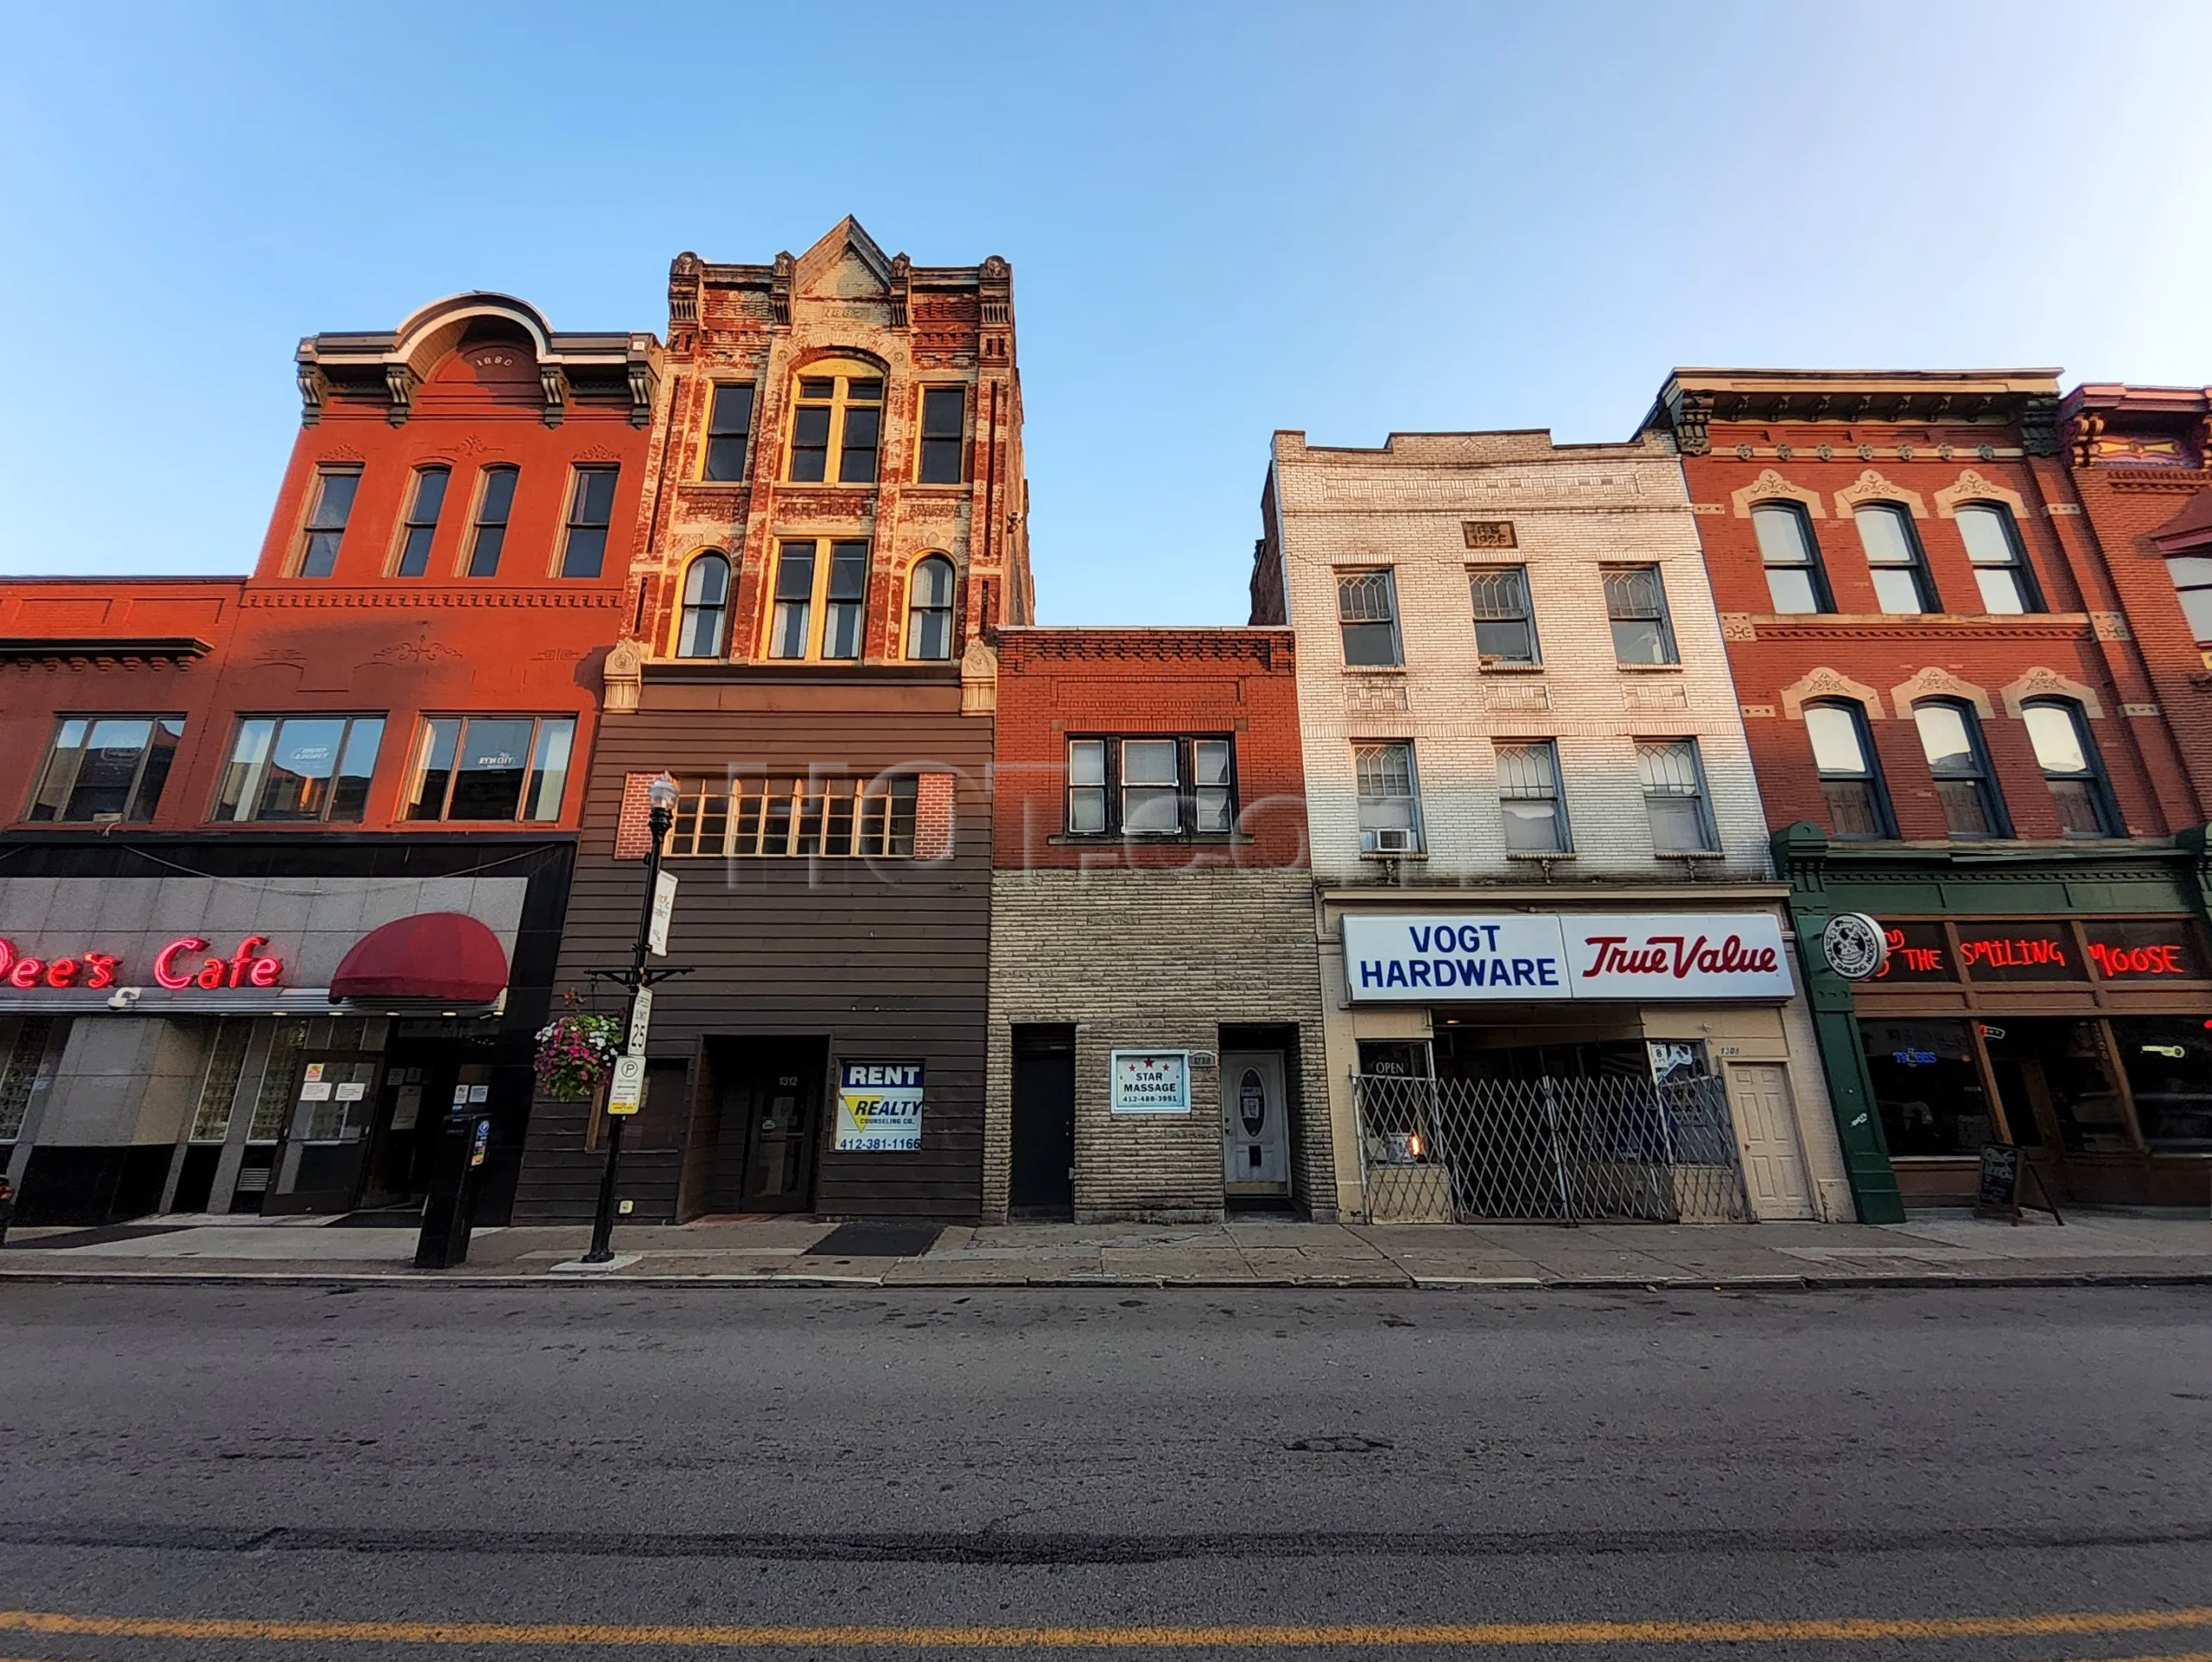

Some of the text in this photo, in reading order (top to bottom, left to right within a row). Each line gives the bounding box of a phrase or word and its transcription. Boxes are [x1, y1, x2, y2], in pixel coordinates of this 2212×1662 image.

[476, 356, 513, 366] 1880
[1409, 925, 1501, 953] VOGT
[154, 936, 283, 989] Cafe
[1582, 934, 1778, 979] True Value
[1901, 939, 2184, 977] THE SMILING MOOSE
[1361, 958, 1560, 988] HARDWARE
[631, 1022, 645, 1048] 25
[849, 1066, 920, 1085] RENT
[1135, 1072, 1163, 1081] STAR
[1376, 1061, 1404, 1073] OPEN
[1123, 1083, 1176, 1092] MASSAGE
[855, 1100, 923, 1116] REALTY
[840, 1138, 921, 1149] 412-381-1166
